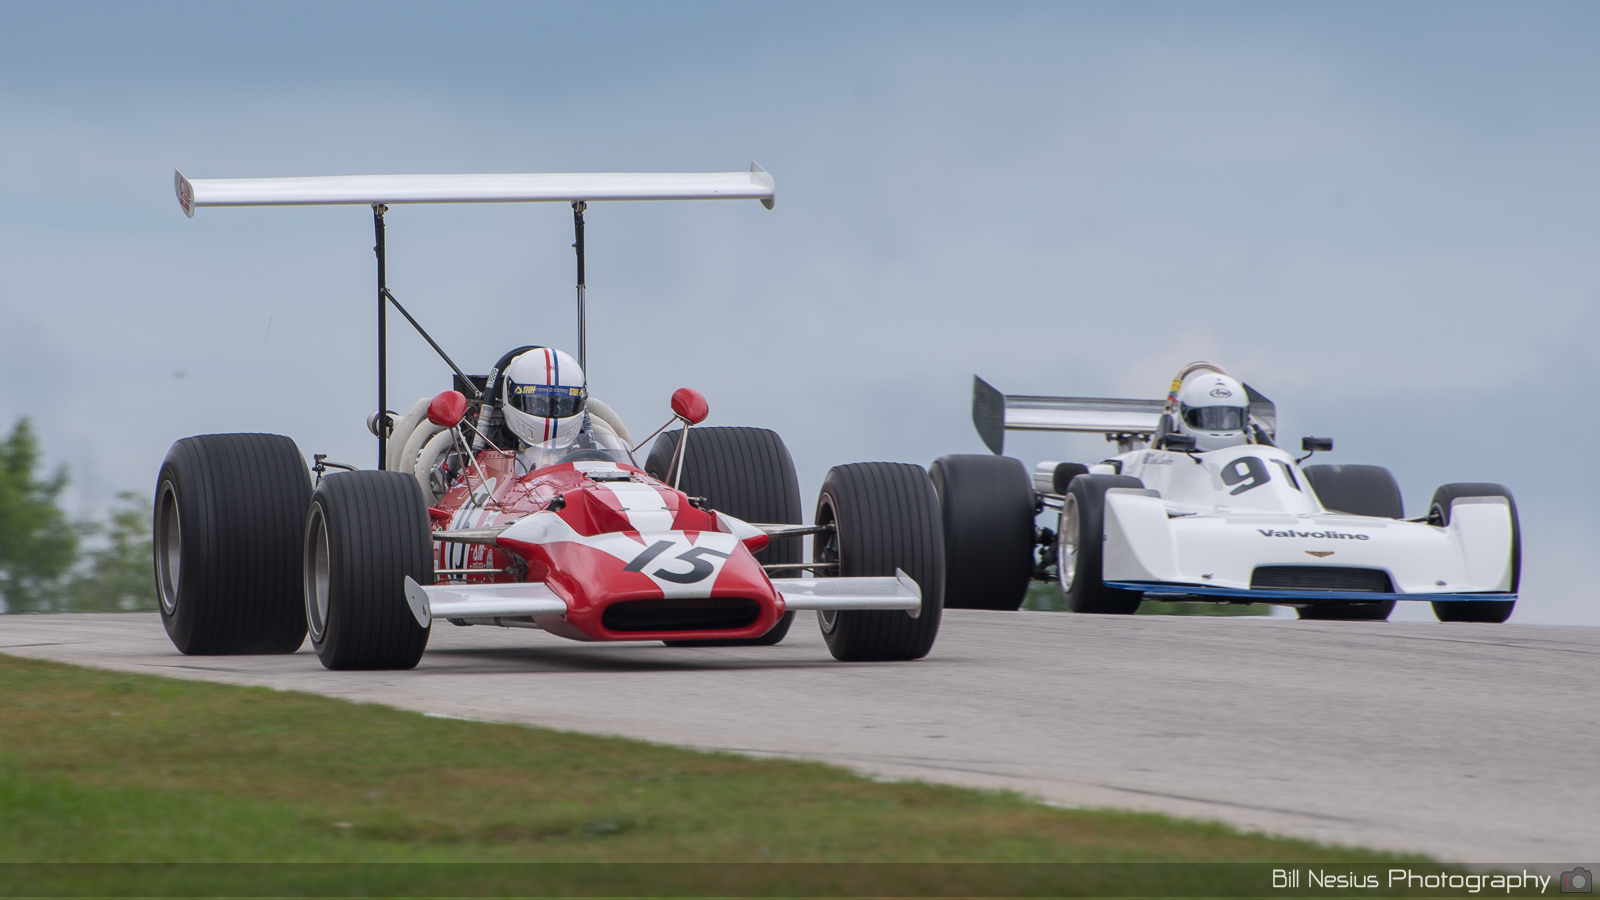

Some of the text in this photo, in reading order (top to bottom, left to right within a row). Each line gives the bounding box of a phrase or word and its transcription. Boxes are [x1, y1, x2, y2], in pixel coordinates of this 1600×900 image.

[1220, 456, 1303, 496] 91
[1257, 529, 1370, 541] Valvoline
[622, 540, 733, 585] 15
